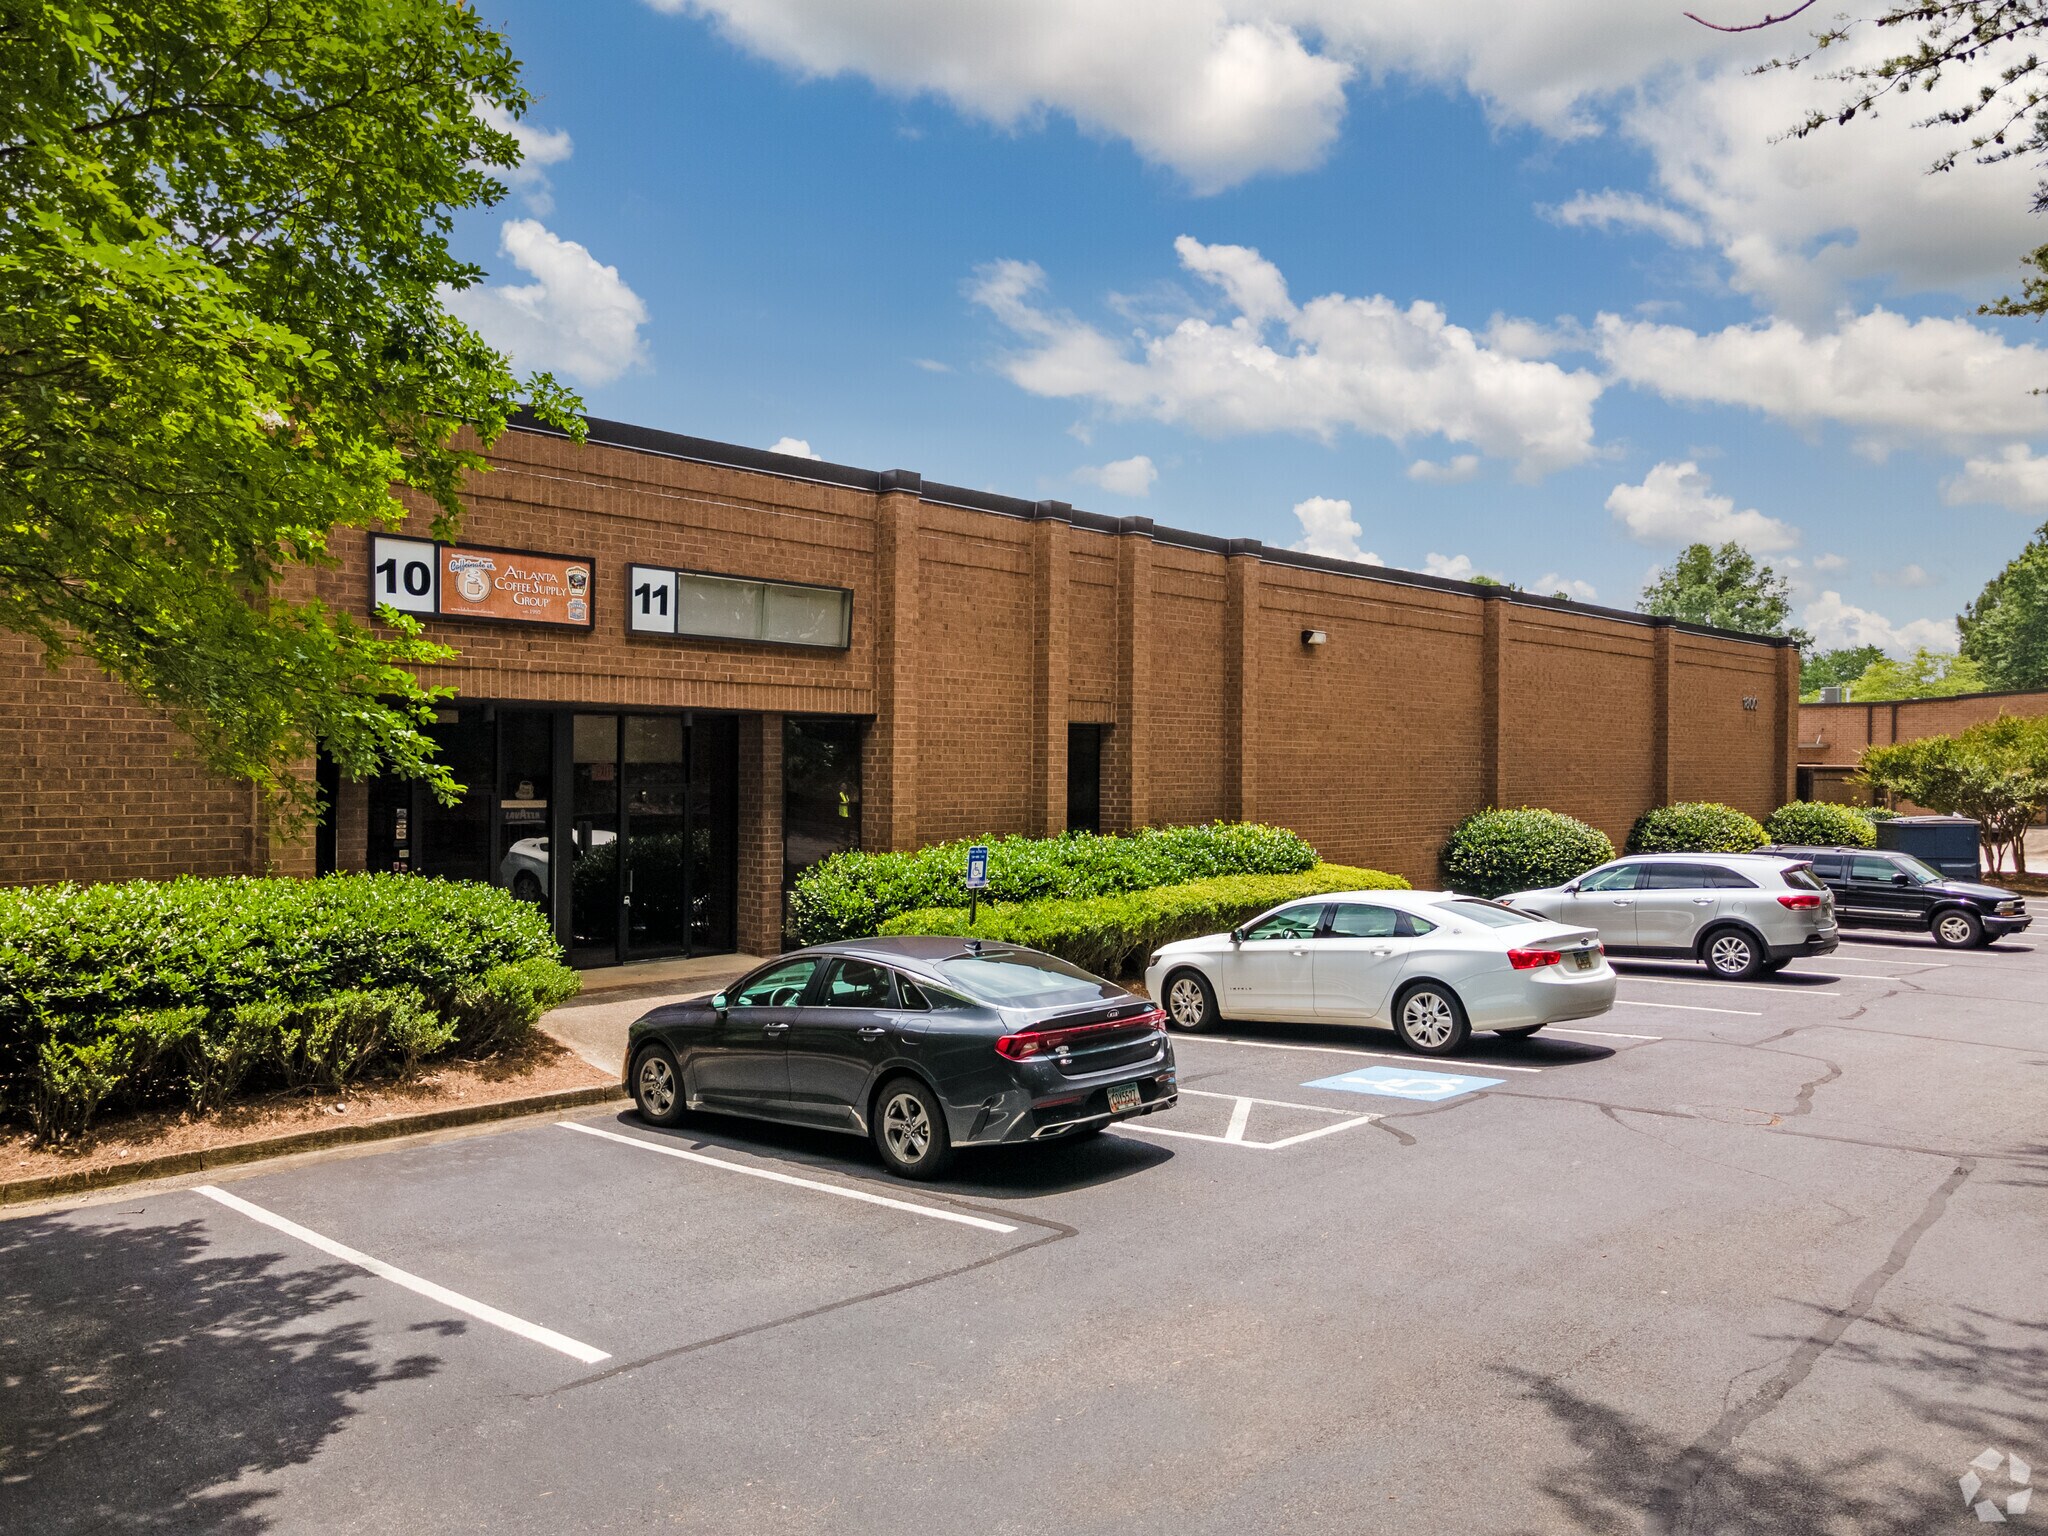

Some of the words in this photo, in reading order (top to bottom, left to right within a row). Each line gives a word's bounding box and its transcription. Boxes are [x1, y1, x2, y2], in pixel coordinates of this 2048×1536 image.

[376, 558, 431, 596] 10
[504, 565, 558, 584] ATLANTA
[494, 576, 531, 593] COFFEE
[531, 581, 567, 597] SUPPLY
[513, 591, 549, 608] GROUP
[634, 582, 668, 616] 11
